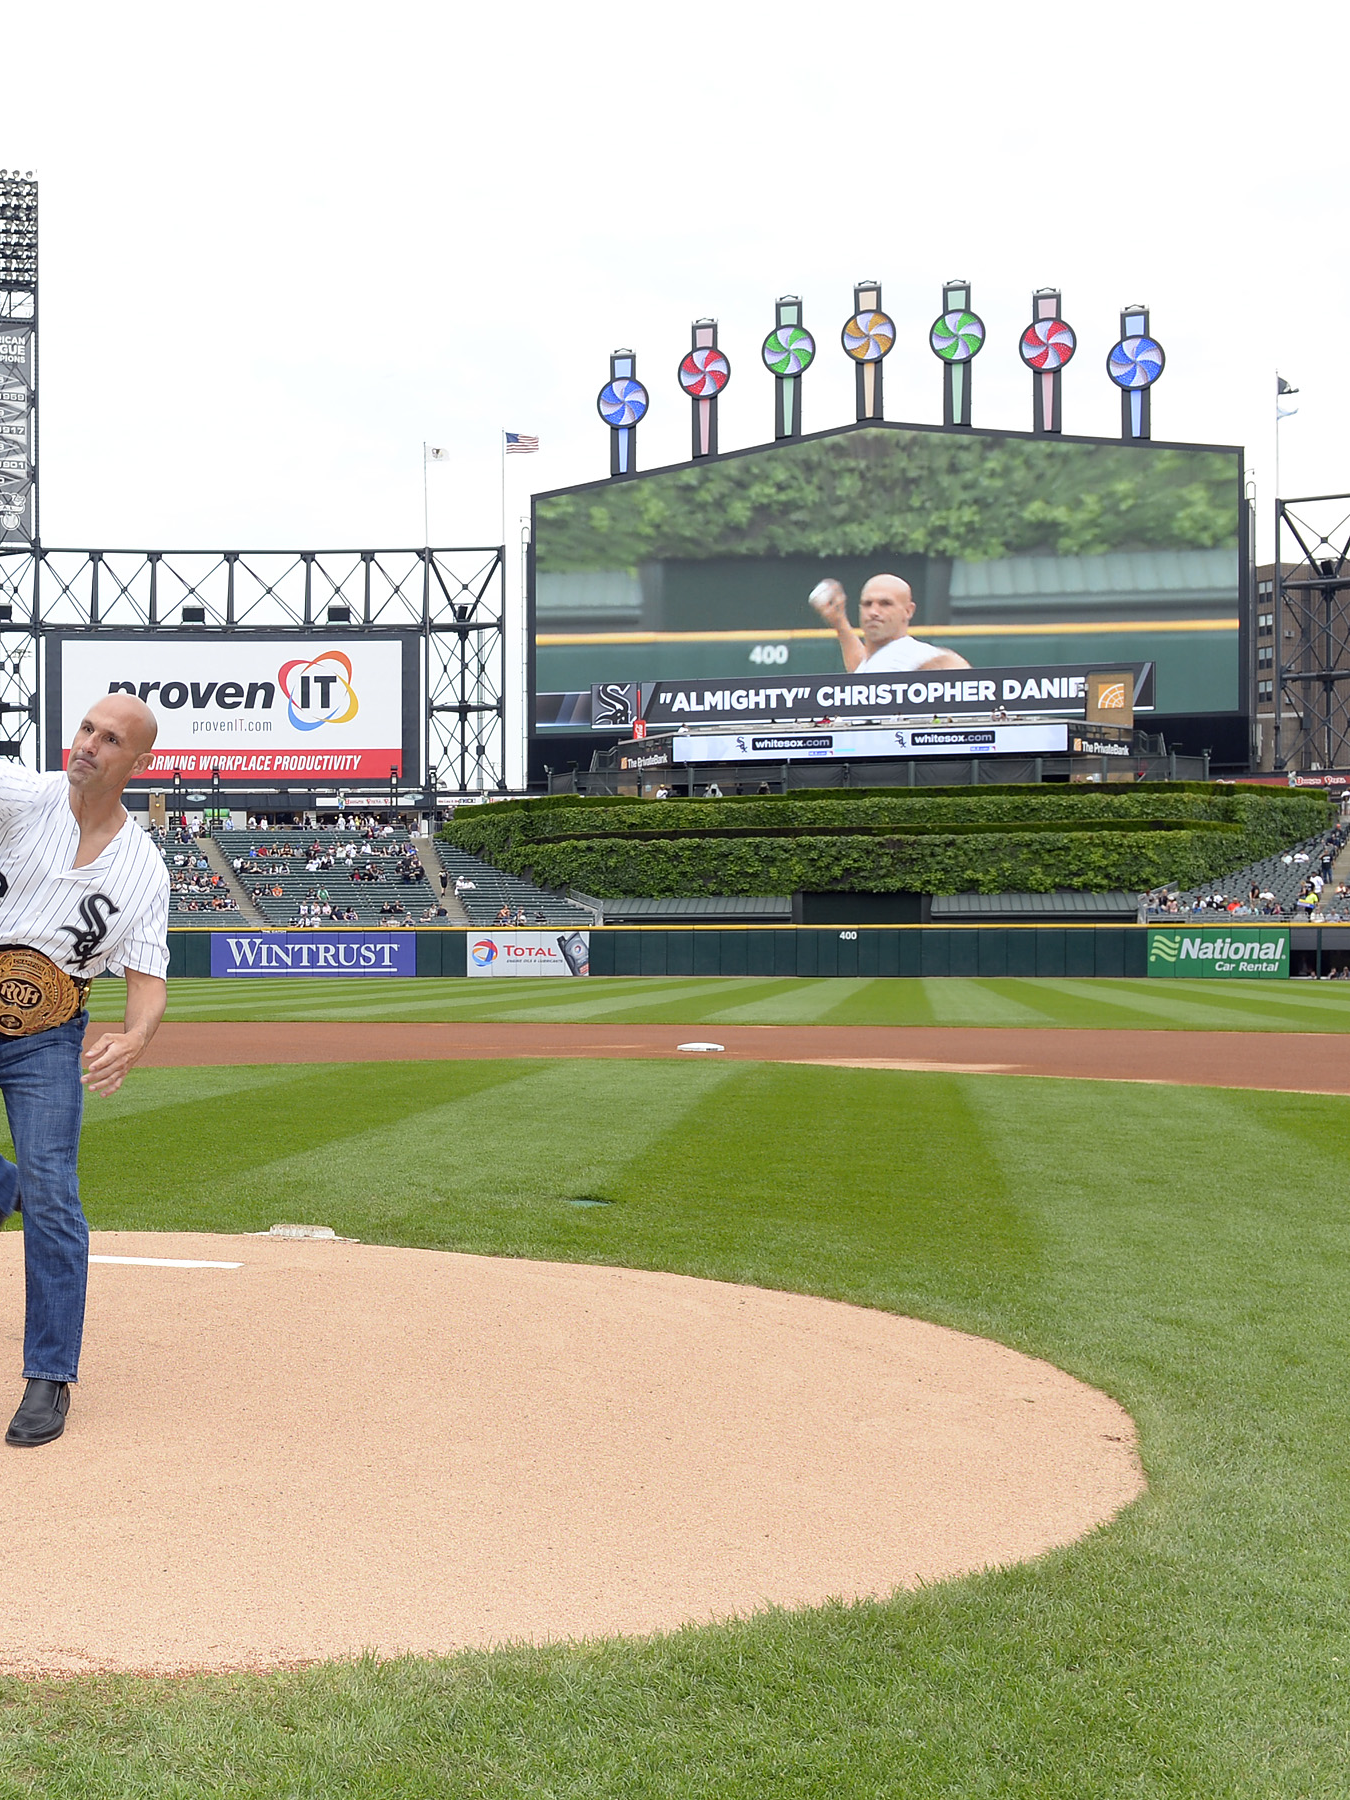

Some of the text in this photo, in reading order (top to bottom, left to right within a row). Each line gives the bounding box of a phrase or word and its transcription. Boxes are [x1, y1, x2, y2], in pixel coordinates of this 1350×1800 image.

[750, 645, 789, 664] 400
[301, 676, 337, 709] IT
[660, 686, 810, 712] "ALMIGHTY"
[816, 680, 996, 706] CHRISTOPHER
[192, 718, 272, 734] provenIT.com
[755, 738, 831, 749] whitesox.com
[914, 733, 992, 744] whitesox.com
[1082, 740, 1130, 756] The PrivateBank
[199, 756, 272, 771] WORKPLACE
[274, 755, 362, 771] PRODUCTIVITY
[628, 754, 668, 770] The PrivateBank
[840, 931, 858, 940] 400
[226, 938, 399, 966] WINTRUST
[503, 946, 557, 956] TOTAL
[1180, 938, 1285, 960] National
[1216, 962, 1278, 972] Car Rental
